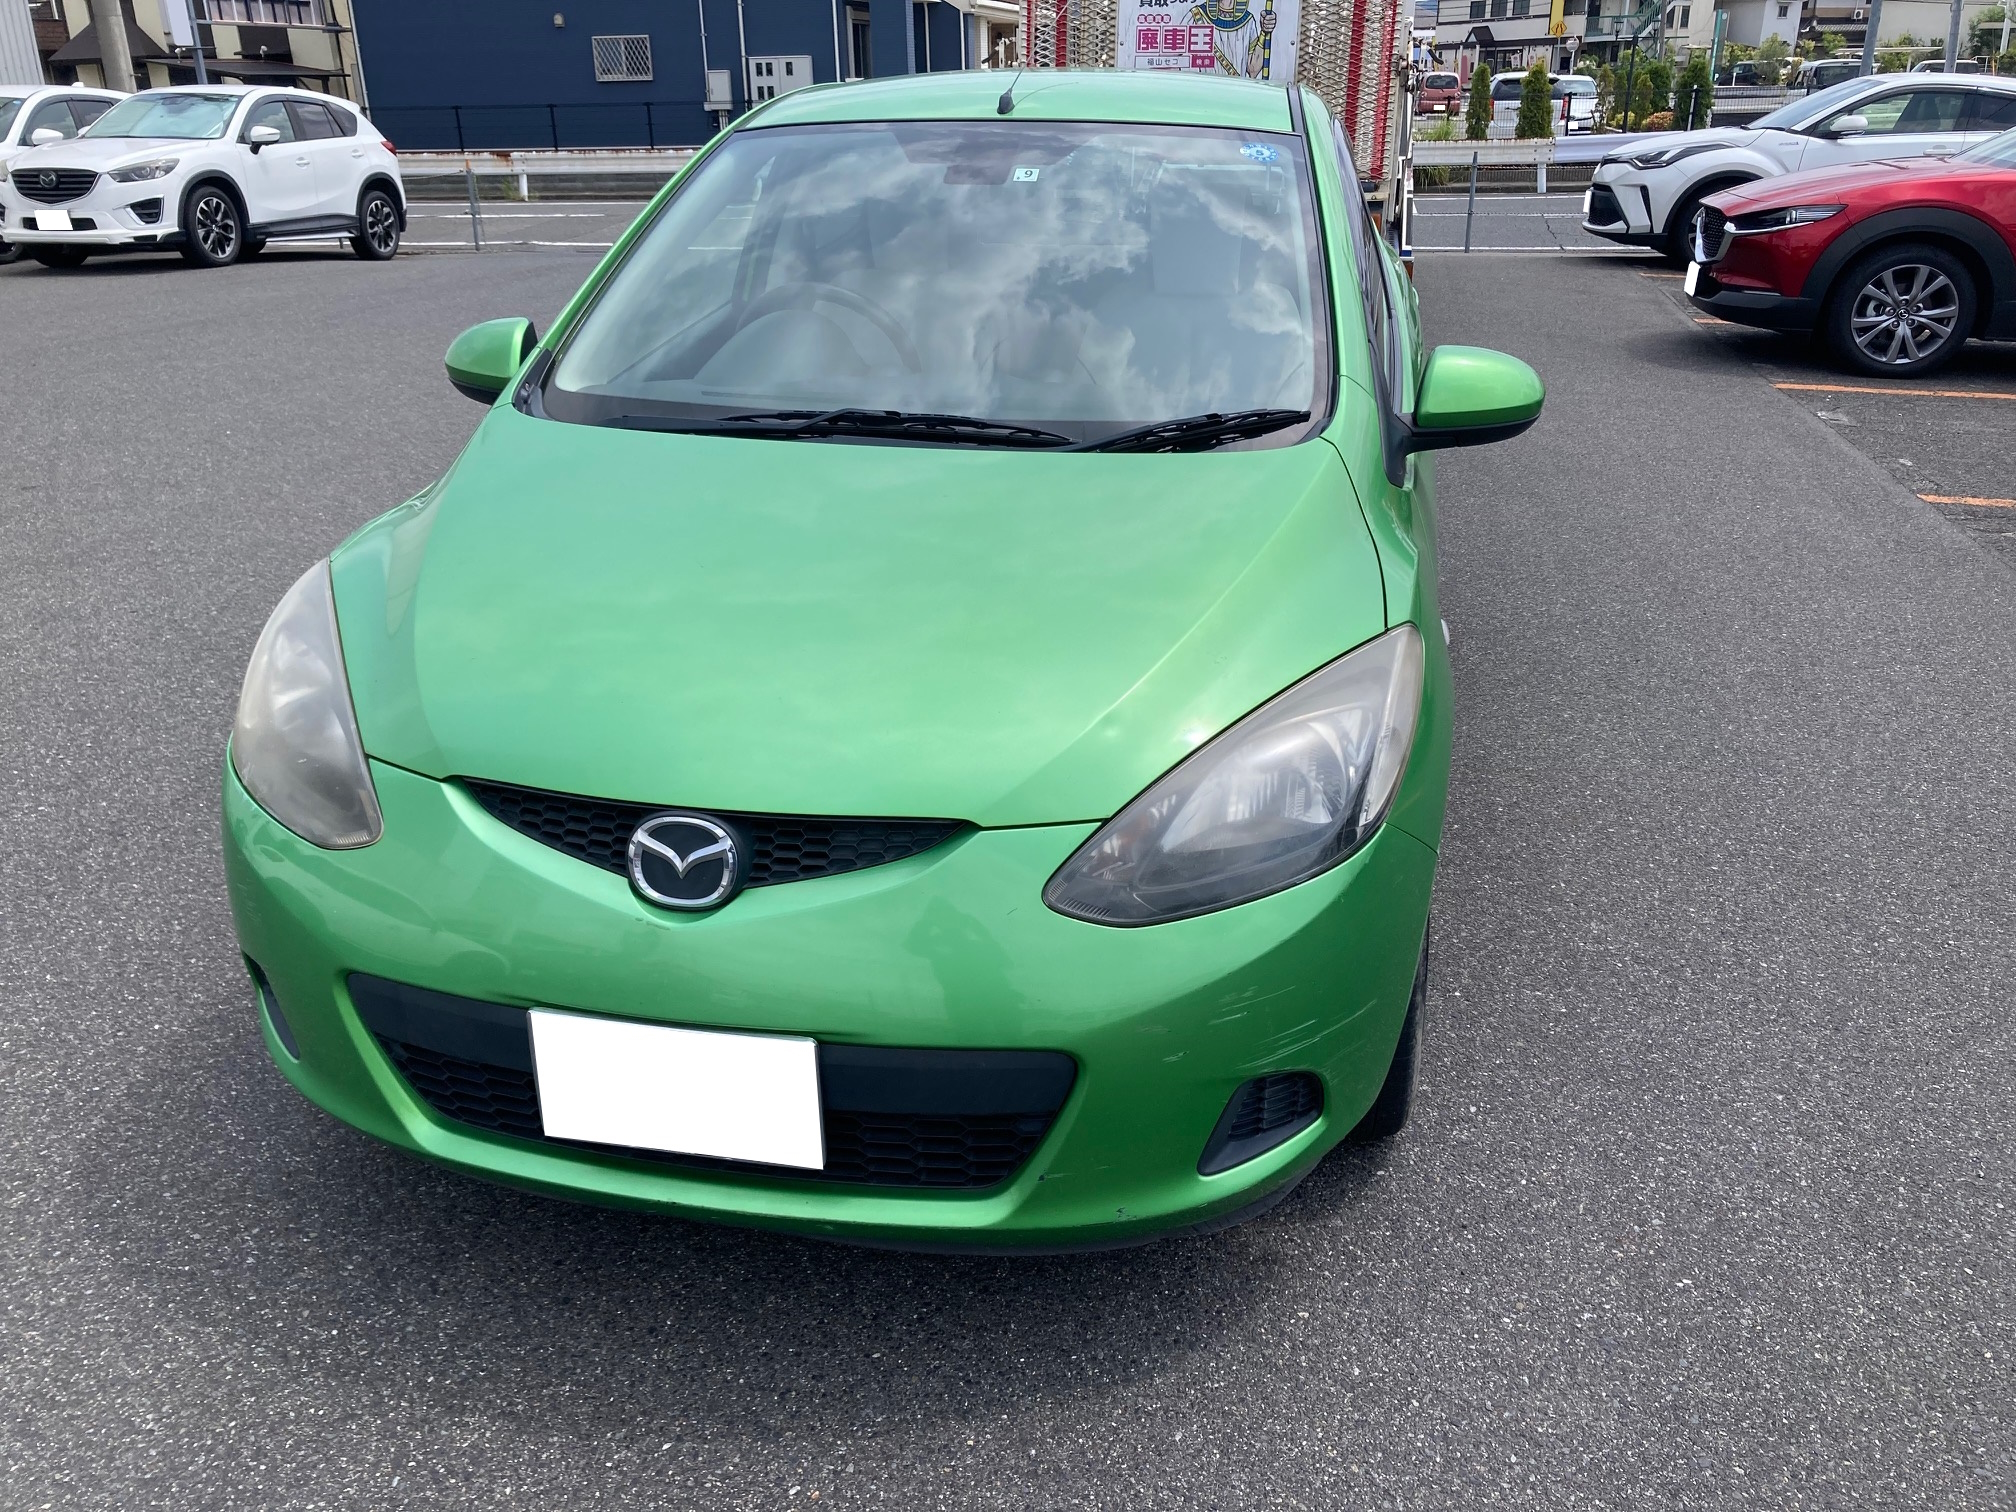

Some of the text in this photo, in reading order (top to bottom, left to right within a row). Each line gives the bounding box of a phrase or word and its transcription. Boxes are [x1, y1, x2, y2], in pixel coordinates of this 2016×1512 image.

[1137, 27, 1213, 53] 廃車王
[1024, 169, 1034, 178] 9
